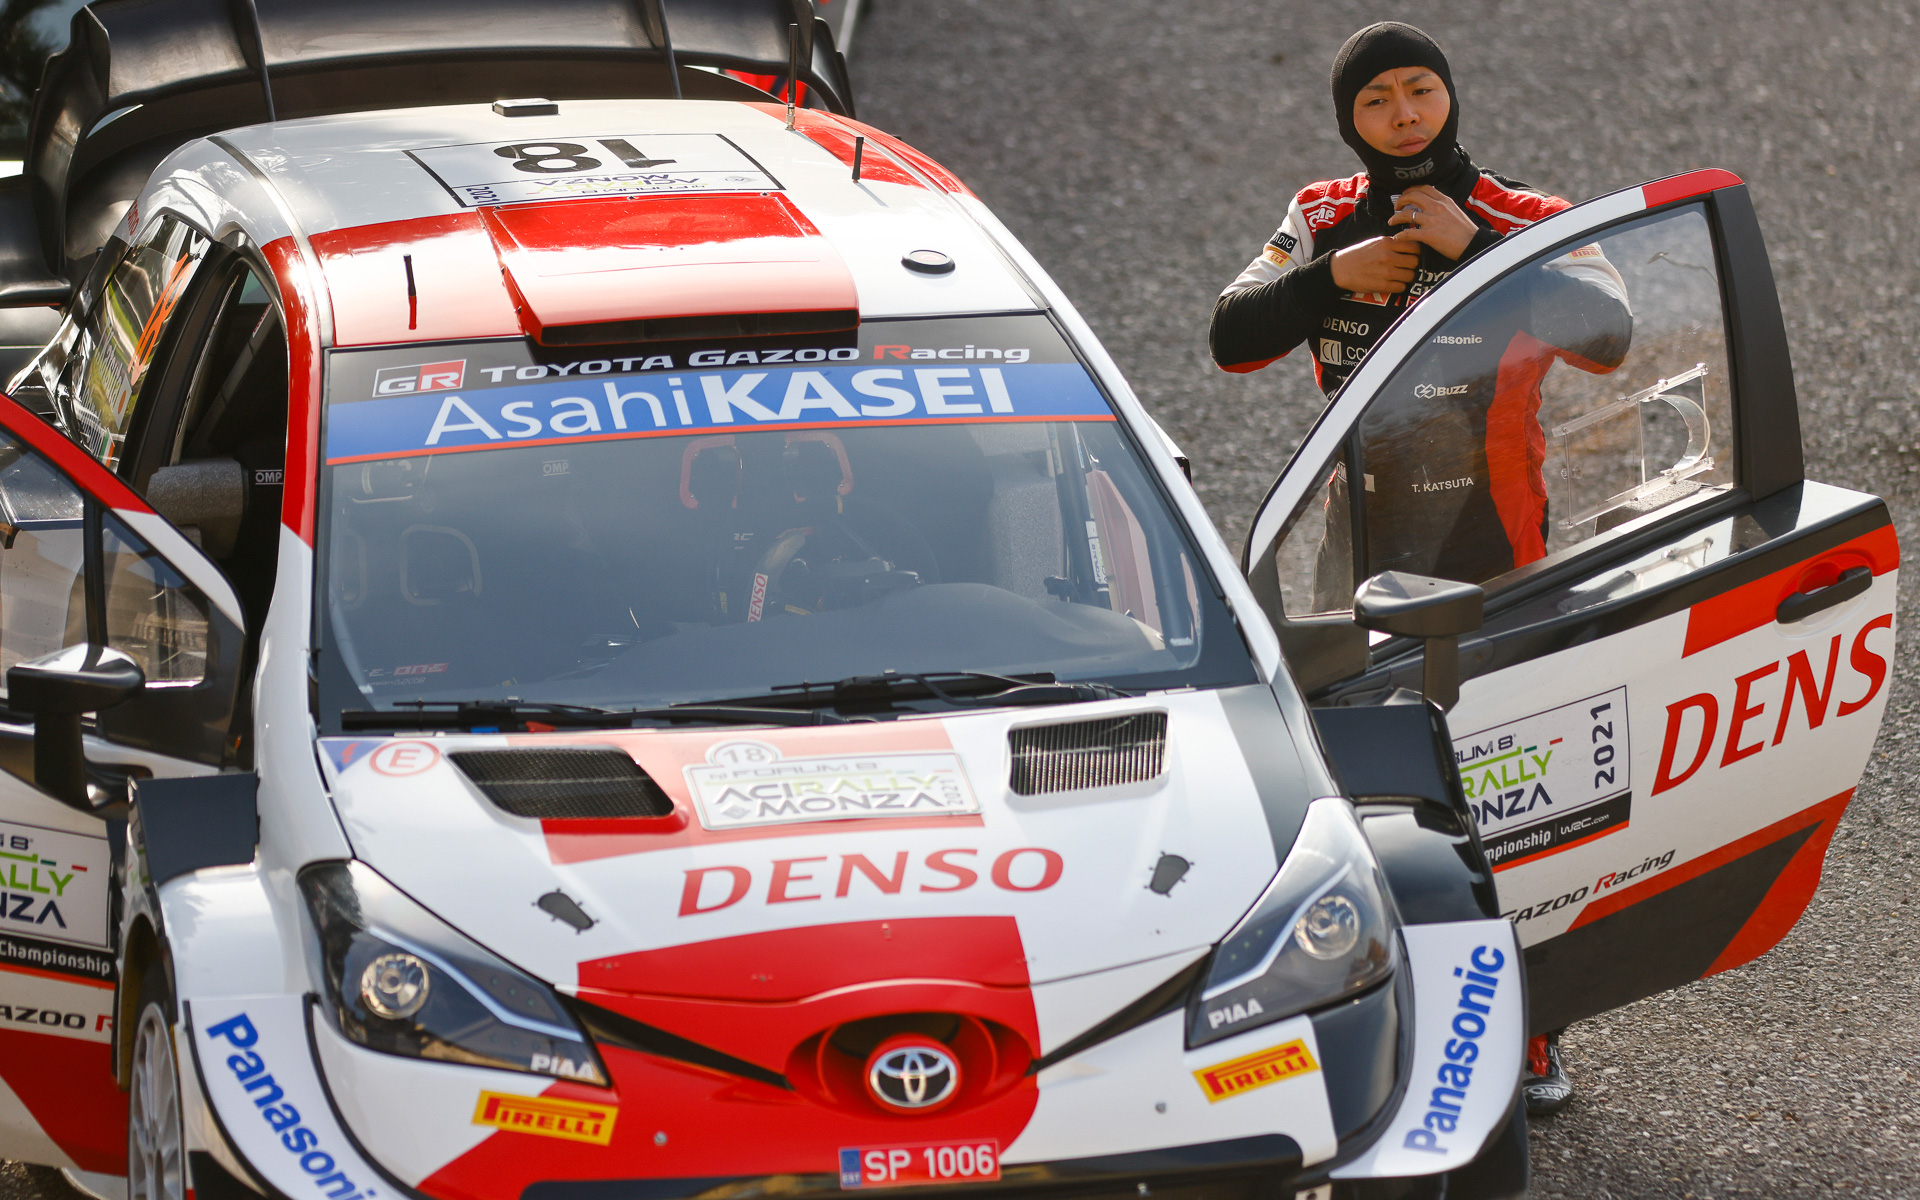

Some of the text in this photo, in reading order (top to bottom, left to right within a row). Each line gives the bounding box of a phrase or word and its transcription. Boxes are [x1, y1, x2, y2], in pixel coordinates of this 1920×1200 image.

[493, 138, 677, 174] 18
[534, 174, 669, 187] MONZA
[1394, 160, 1435, 180] OMP
[466, 186, 500, 205] 2021
[1323, 317, 1370, 336] DENSO
[480, 344, 1031, 383] TOYOTA GAZOO Racing
[378, 372, 460, 395] GR
[1437, 384, 1469, 397] BUZZ
[255, 471, 283, 483] OMP
[542, 461, 570, 475] OMP
[1411, 477, 1474, 492] T. KATSUTA
[1650, 613, 1893, 797] DENS
[1498, 734, 1513, 751] 8
[1590, 702, 1615, 789] 2021
[388, 749, 421, 768] E
[722, 748, 766, 764] 18
[732, 762, 849, 778] FORUM
[1460, 750, 1553, 799] RALLY
[758, 791, 945, 817] MONZA
[10, 835, 29, 851] 8
[678, 847, 1064, 918] DENSO
[1593, 849, 1677, 894] Racing
[0, 939, 110, 977] Championship
[1207, 998, 1264, 1029] PIAA
[1403, 945, 1506, 1155] Panasonic
[529, 1053, 595, 1080] PIAA
[1201, 1045, 1310, 1097] PIRELLI
[482, 1096, 607, 1137] PIRELLI
[864, 1148, 911, 1182] SP
[923, 1143, 995, 1179] 1006
